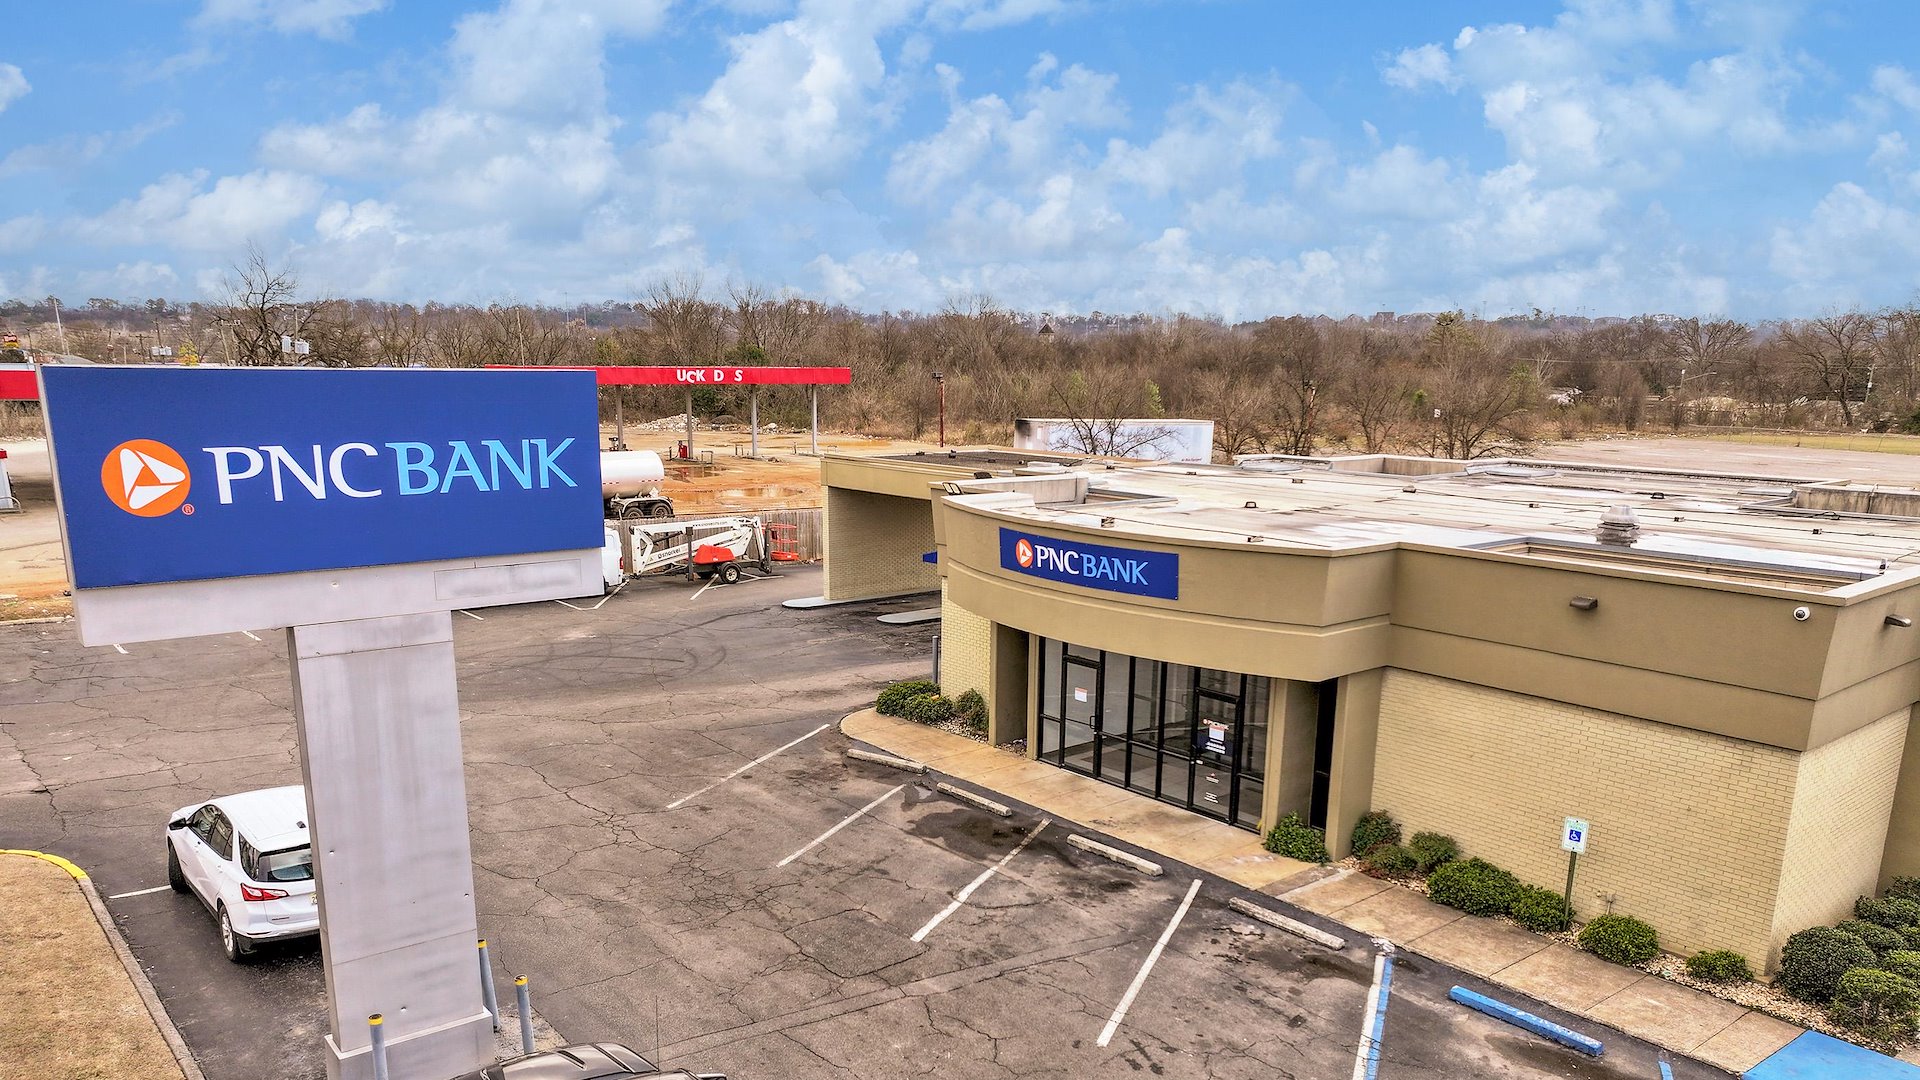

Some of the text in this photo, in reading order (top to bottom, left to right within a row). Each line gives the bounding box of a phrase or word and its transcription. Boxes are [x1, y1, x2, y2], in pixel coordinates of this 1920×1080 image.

[202, 437, 578, 505] PNC BANK
[1034, 544, 1149, 586] PNC BANK
